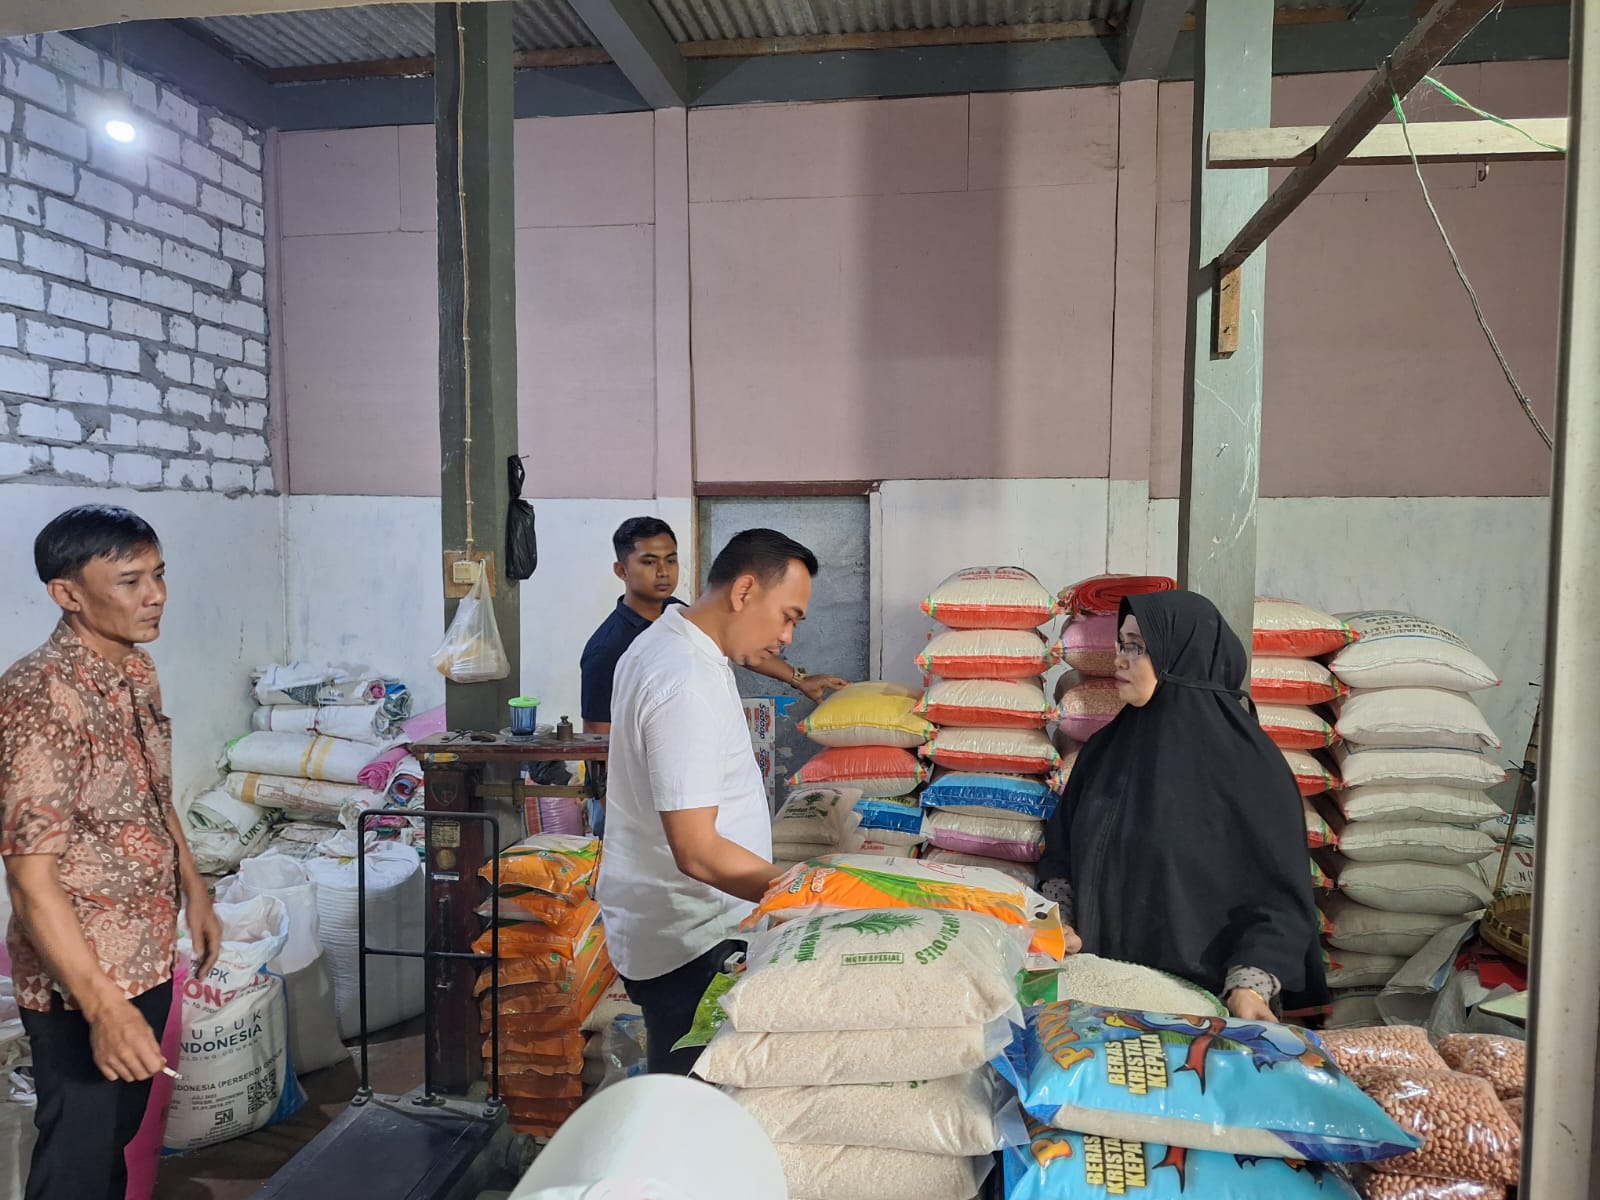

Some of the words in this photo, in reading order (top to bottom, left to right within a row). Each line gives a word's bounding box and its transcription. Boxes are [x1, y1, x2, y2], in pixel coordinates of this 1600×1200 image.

[180, 1023, 263, 1055] NDONESIA
[1105, 1041, 1126, 1085] BERAS
[1141, 1033, 1168, 1088] KEPALA
[174, 1083, 216, 1092] DONESIA
[1124, 1038, 1148, 1094] KRISTAL
[1084, 1136, 1105, 1185] BERAS
[1103, 1137, 1126, 1194] KRISTA
[1122, 1140, 1147, 1187] KEPA
